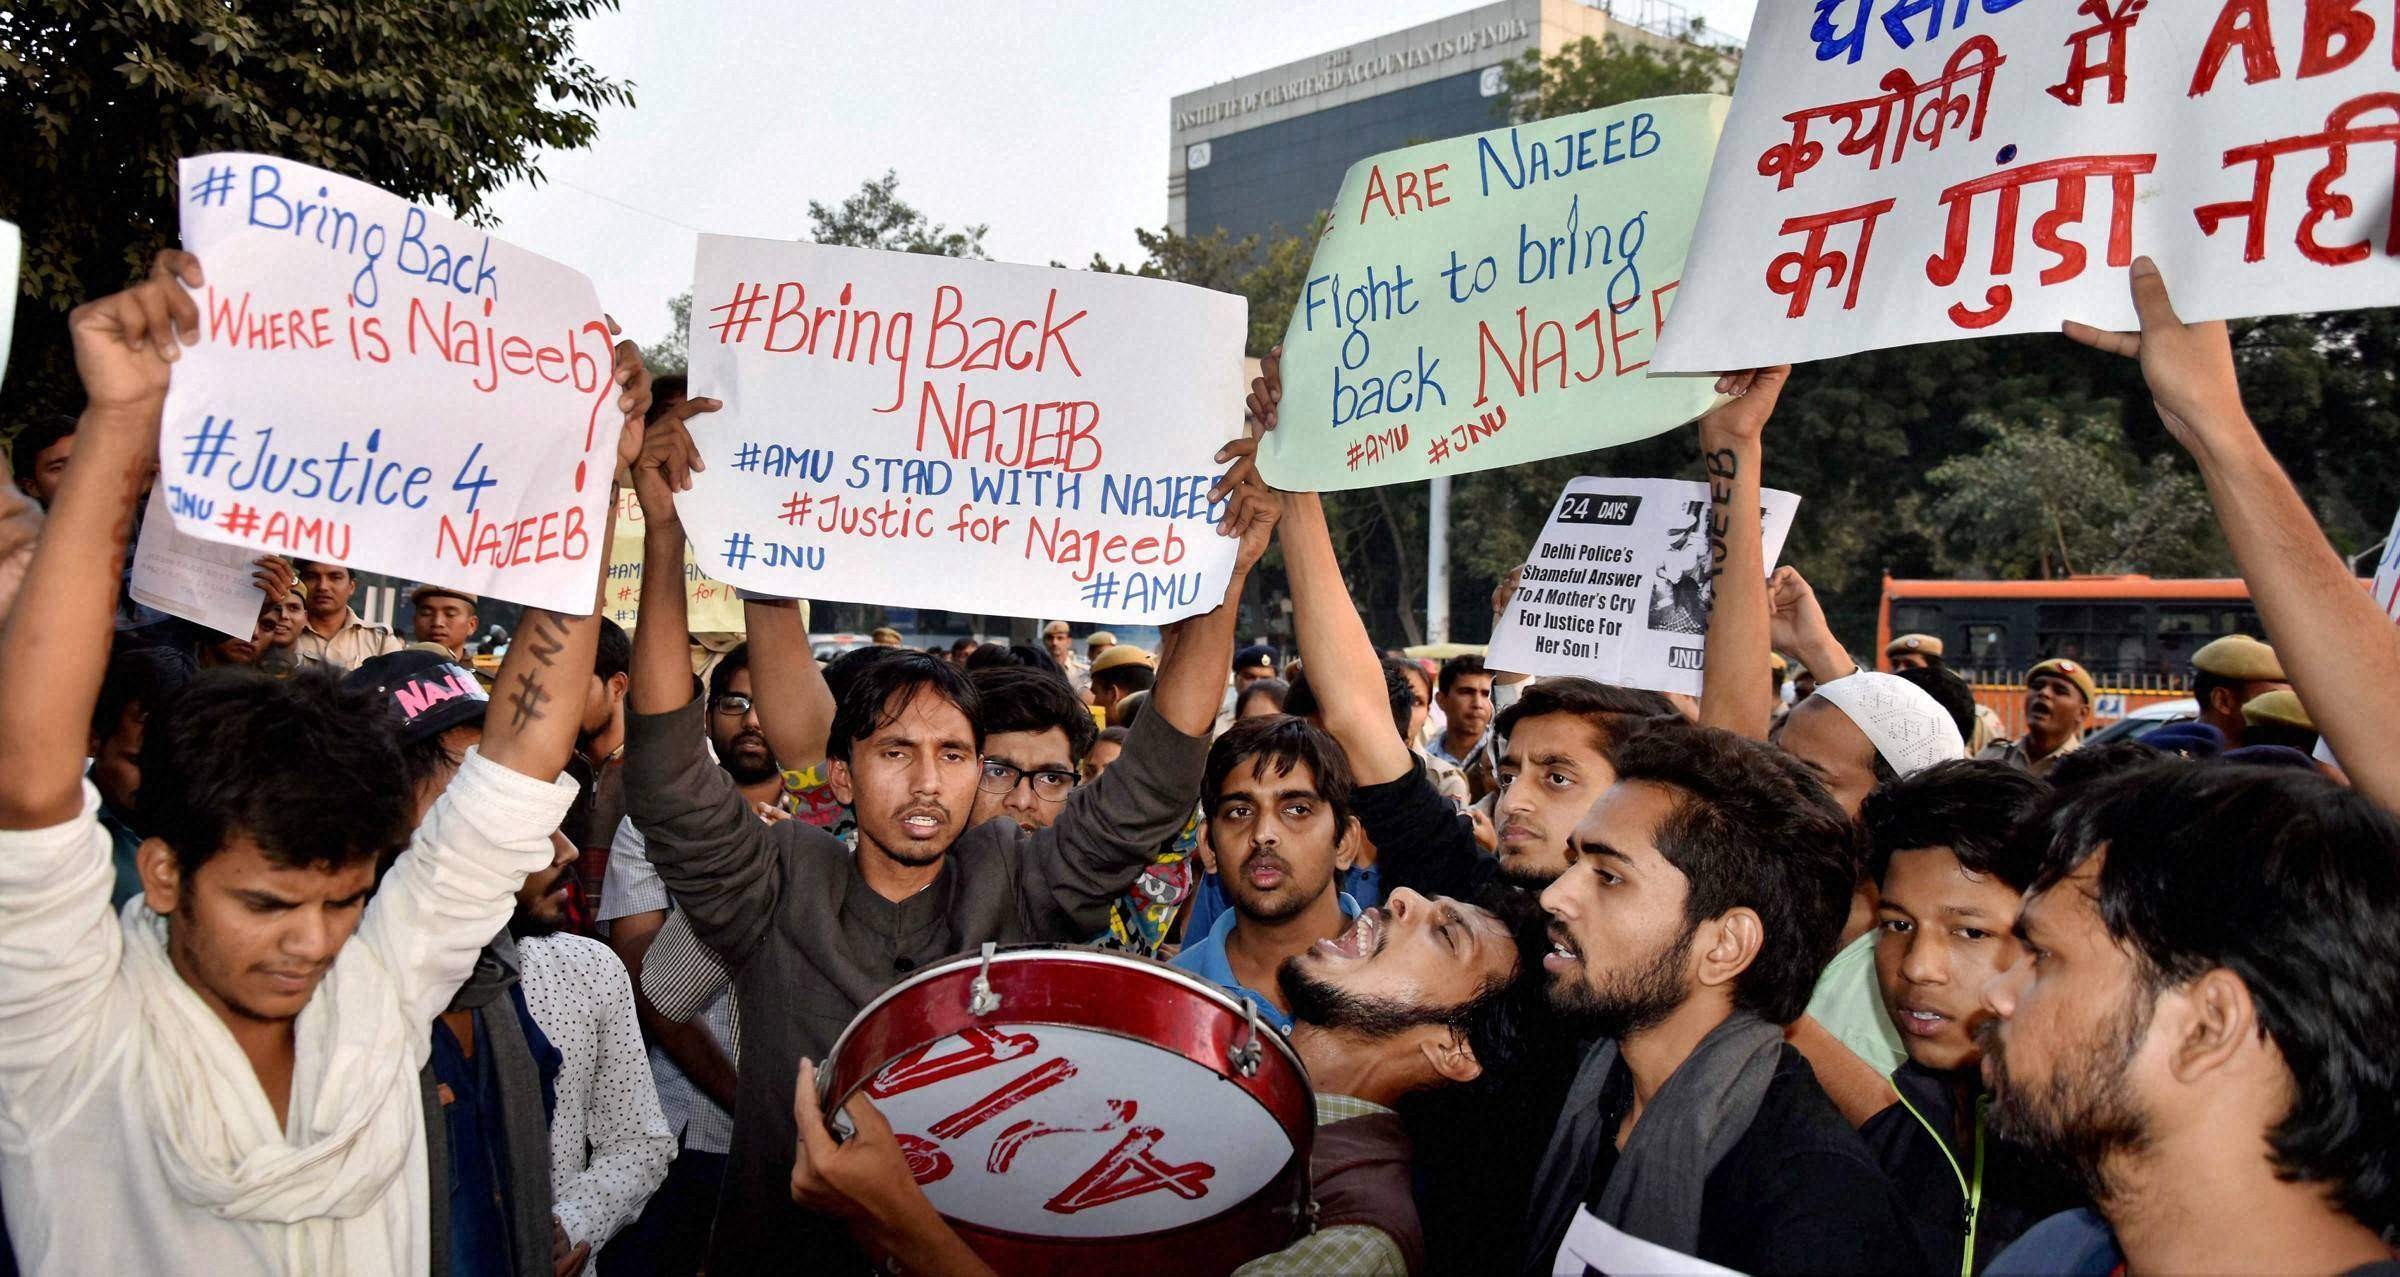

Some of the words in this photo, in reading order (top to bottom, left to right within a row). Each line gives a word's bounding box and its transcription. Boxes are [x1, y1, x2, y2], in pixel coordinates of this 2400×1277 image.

[1176, 99, 1242, 131] INSTITUTE
[1242, 94, 1261, 113] OF
[1261, 68, 1344, 108] CHARTERED
[1347, 39, 1456, 86] ACCOUNTANTS
[1457, 29, 1478, 54] OF
[1481, 18, 1528, 48] INDIA
[1325, 50, 1350, 70] THE
[2186, 0, 2400, 99] AB
[1361, 163, 1451, 225] ARE
[1478, 112, 1662, 197] NAJEEB
[190, 163, 384, 307] #Bring
[396, 207, 498, 300] Back
[1766, 197, 1896, 319] का
[1926, 143, 2158, 329] गुंडा
[1305, 262, 1420, 370] Fight
[1441, 250, 1497, 303] to
[1518, 194, 1648, 315] bring
[208, 286, 334, 350] WHERE
[347, 293, 393, 365] is
[709, 281, 913, 413] #Bring
[925, 286, 1088, 377] Back
[1332, 345, 1447, 428] back
[182, 415, 432, 510] #Justice
[453, 443, 498, 513] 4
[1346, 423, 1410, 473] #AMU
[1426, 404, 1507, 466] #JNU
[730, 442, 834, 484] #AMU
[970, 467, 1082, 510] WITH
[1558, 497, 1590, 520] 24
[1597, 501, 1629, 521] DAYS
[168, 485, 214, 521] JNU
[215, 502, 351, 560] #AMU
[436, 505, 589, 568] NAJEEB
[720, 532, 826, 571] #JNU
[777, 491, 934, 540] #Justic
[946, 502, 1011, 545] for
[1024, 515, 1185, 583] Najeeb
[1540, 543, 1577, 561] Delhi
[1578, 545, 1634, 563] Police's
[691, 582, 719, 604] for
[1080, 571, 1201, 613] #AMU
[1516, 587, 1533, 603] To
[1533, 588, 1545, 604] A
[1544, 588, 1607, 610] Mother's
[1609, 593, 1637, 615] Cry
[1522, 565, 1588, 585] Shameful
[1588, 569, 1643, 588] Answer
[1519, 609, 1542, 628] For
[1543, 611, 1595, 634] Justice
[1598, 617, 1623, 637] For
[1535, 635, 1560, 655] Her
[1562, 638, 1590, 659] Son
[1669, 648, 1704, 670] JNU
